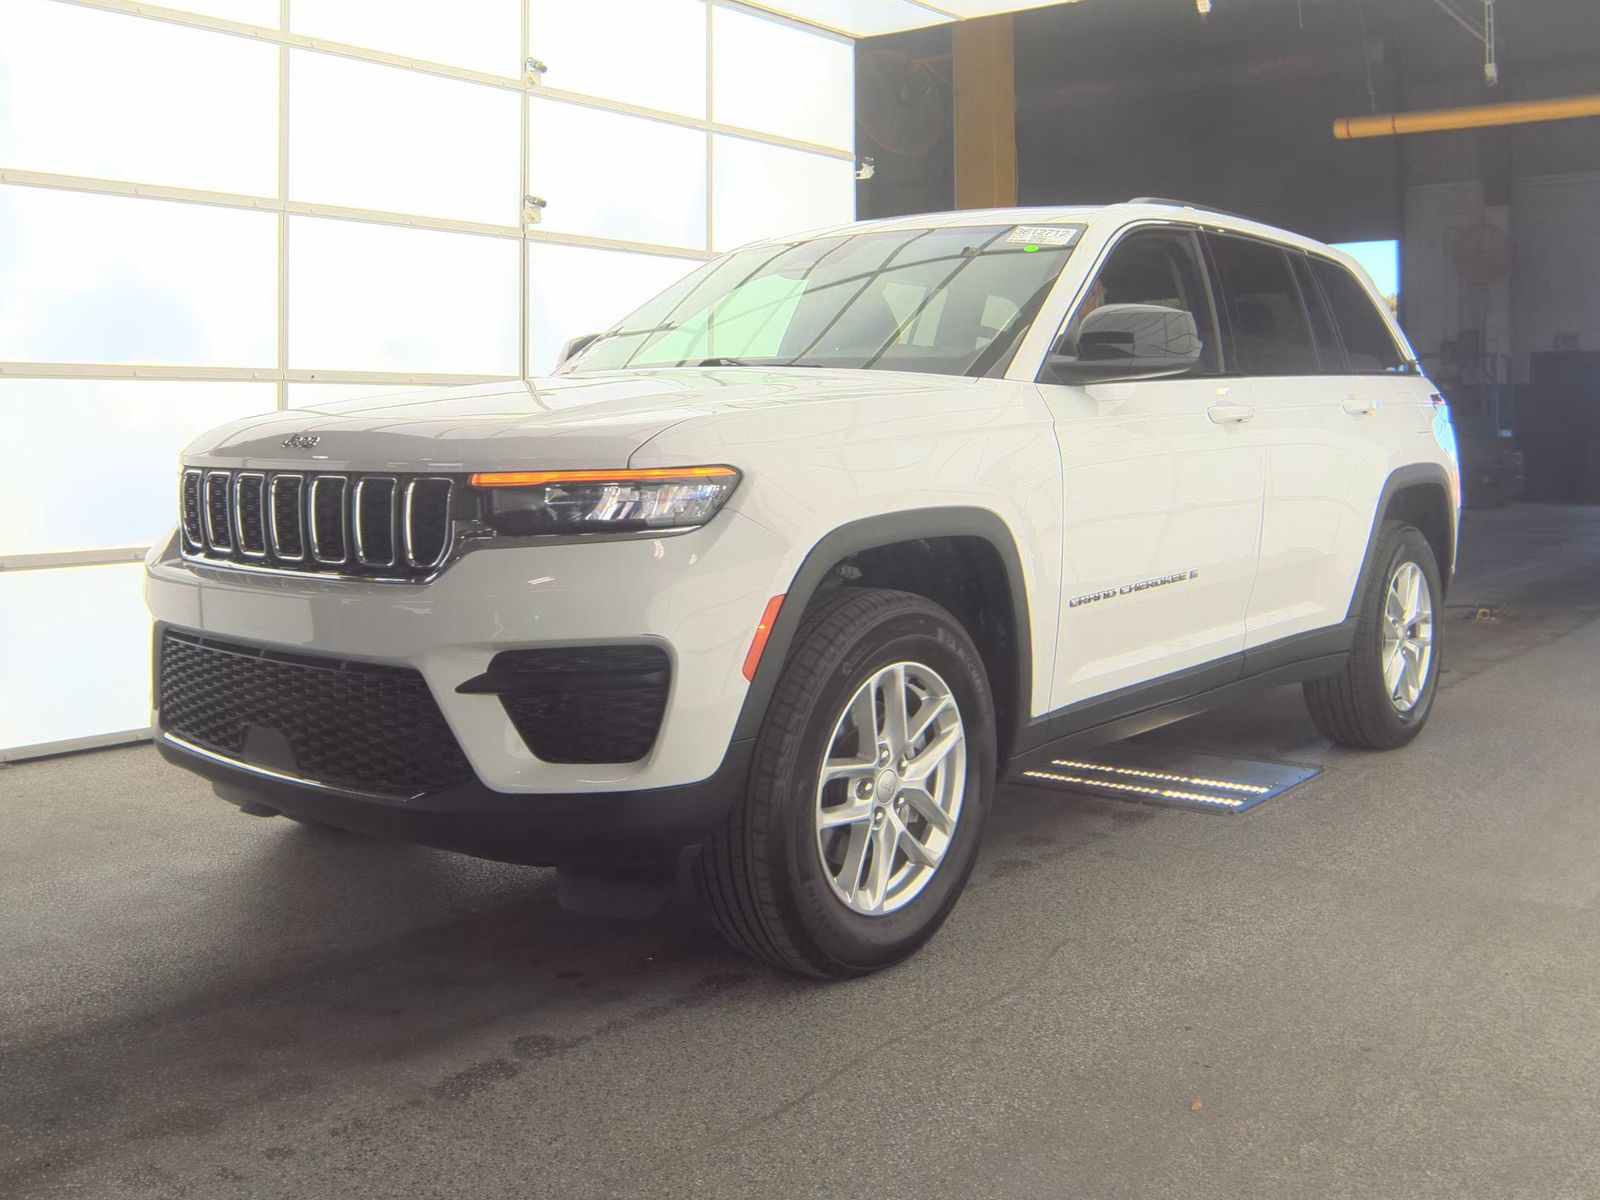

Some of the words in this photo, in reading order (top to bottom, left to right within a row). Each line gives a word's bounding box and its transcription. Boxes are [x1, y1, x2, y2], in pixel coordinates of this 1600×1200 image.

[1014, 227, 1070, 237] 3612712
[280, 433, 320, 449] Jeep
[1069, 588, 1117, 608] GRAND
[1119, 571, 1187, 595] CHEROKEE
